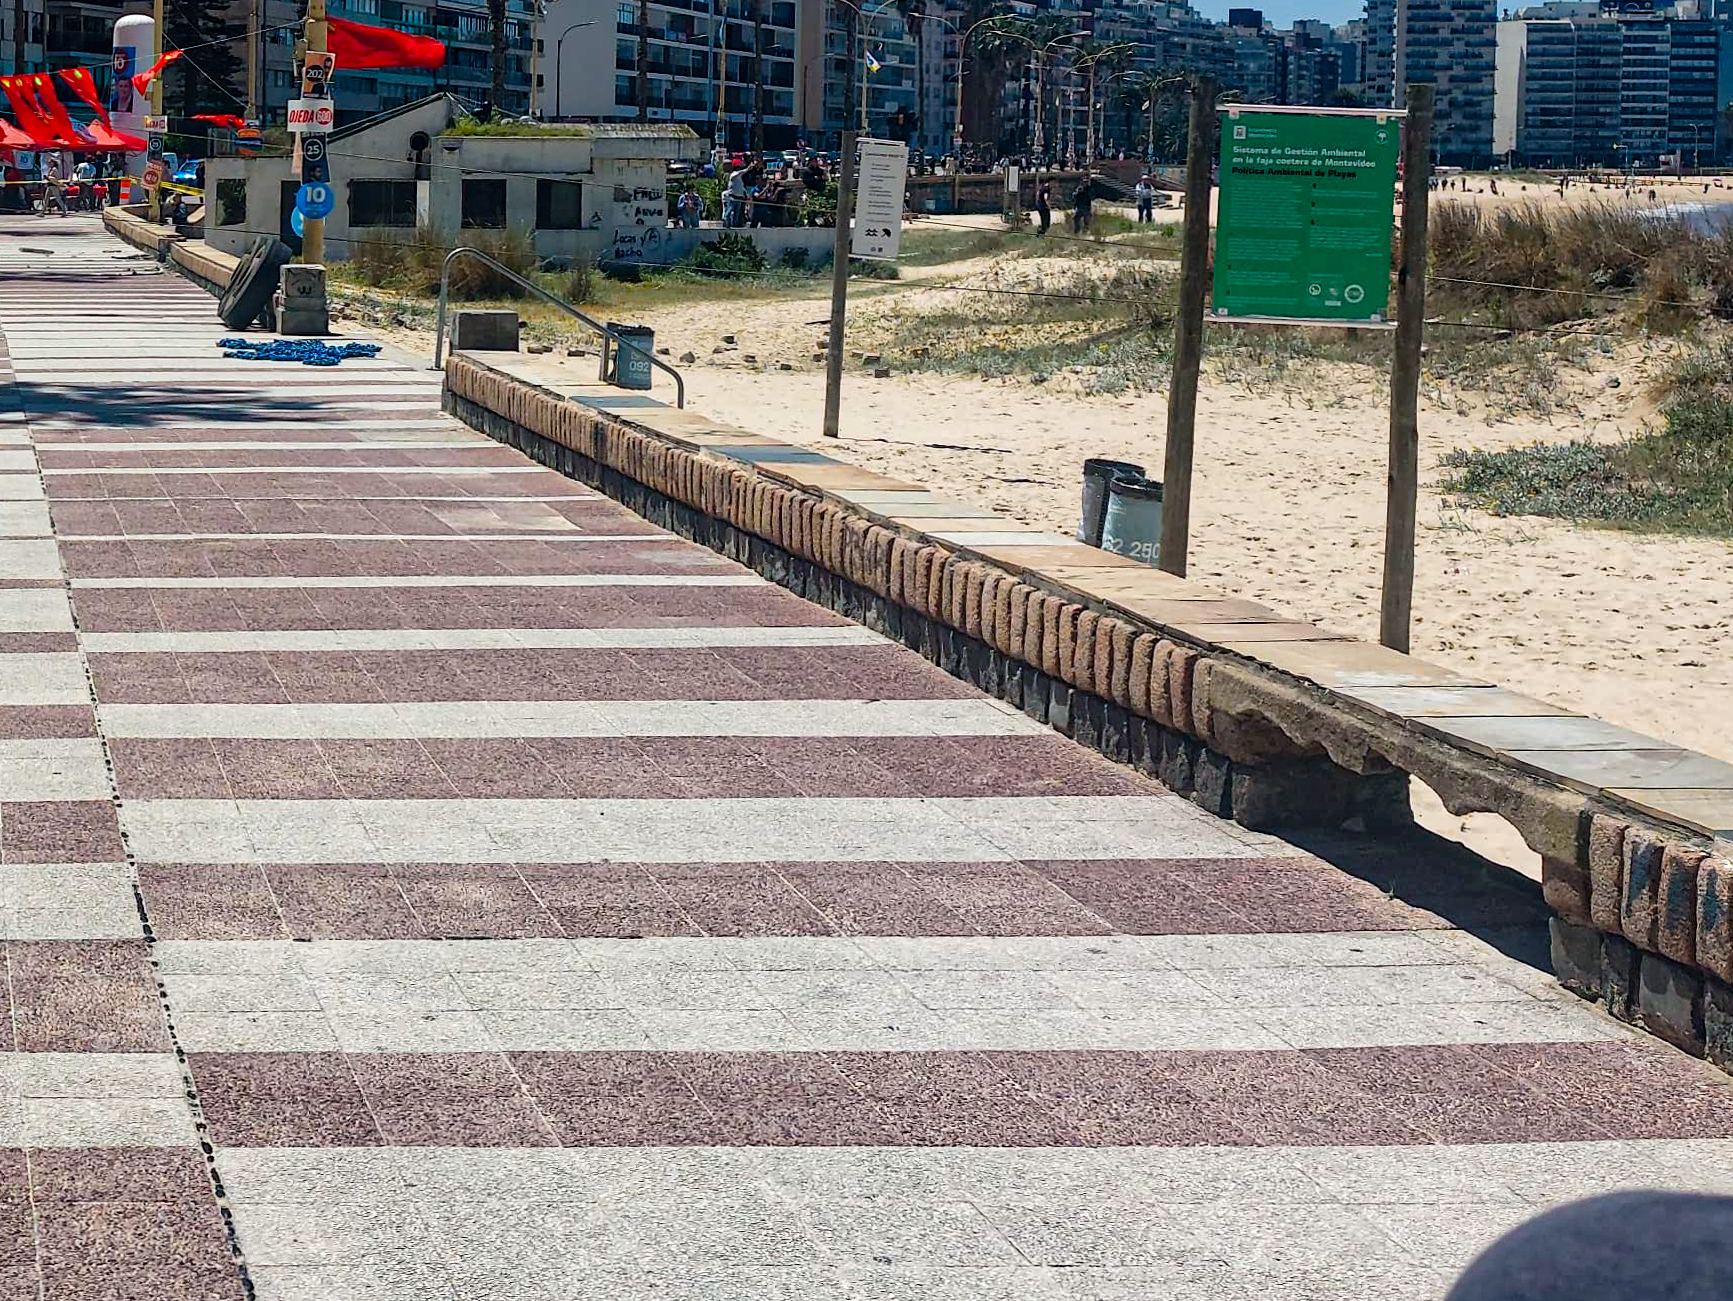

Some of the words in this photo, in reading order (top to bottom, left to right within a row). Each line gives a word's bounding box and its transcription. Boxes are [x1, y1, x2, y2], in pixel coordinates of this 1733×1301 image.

[307, 69, 323, 78] 202
[289, 109, 315, 123] OJEDA
[307, 144, 320, 155] 25
[1233, 146, 1269, 155] Sistema
[1271, 147, 1282, 155] de
[1284, 147, 1318, 156] Gestión
[1321, 148, 1366, 157] Ambiental
[1245, 156, 1254, 164] la
[1276, 158, 1309, 166] costera
[1324, 158, 1376, 167] Montevideo
[1267, 167, 1312, 176] Ambiental
[1314, 169, 1326, 177] de
[1328, 169, 1357, 180] Playas
[306, 186, 326, 203] 10
[628, 360, 650, 372] 092
[1129, 542, 1160, 559] 250
